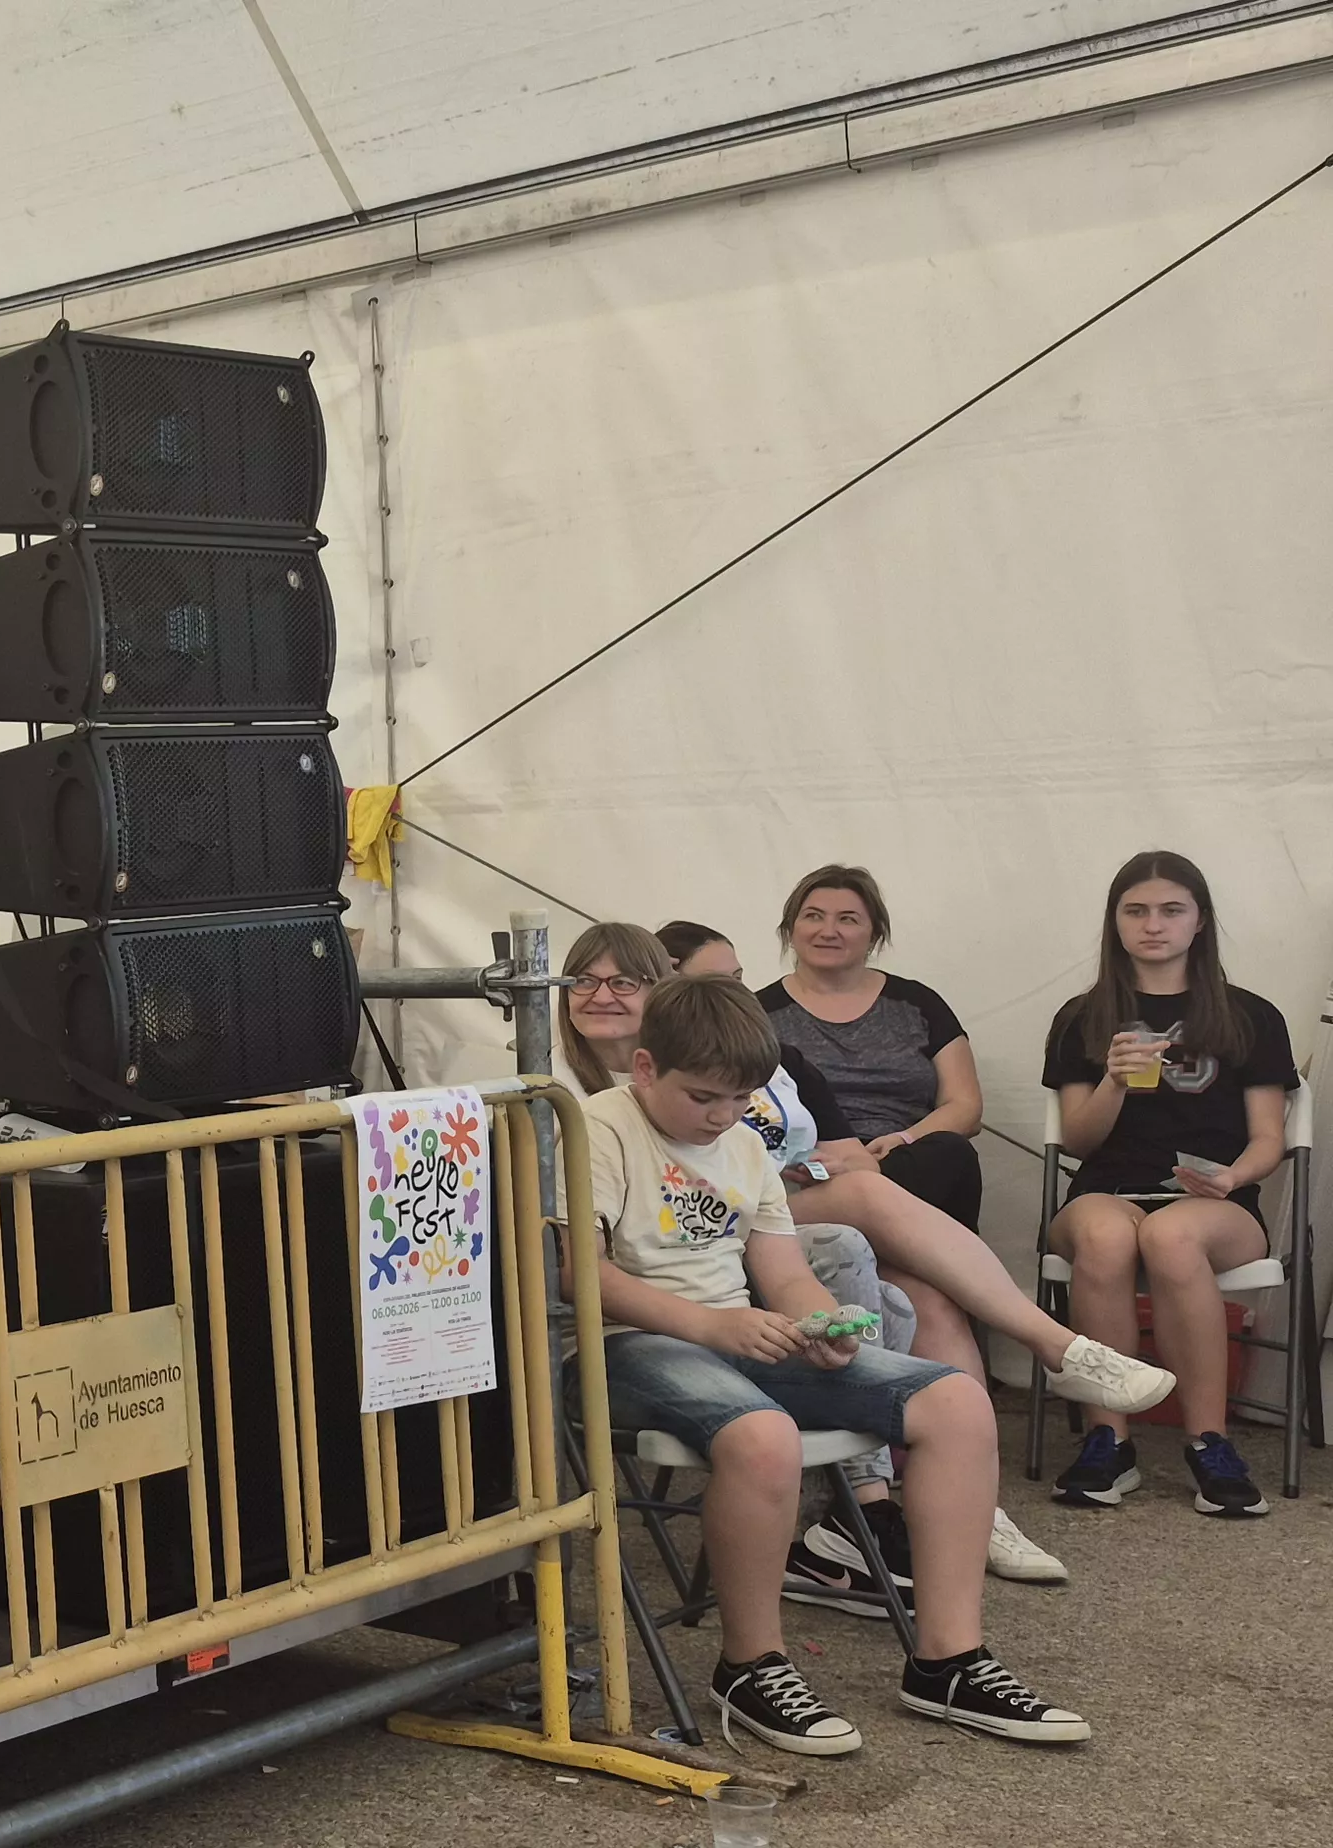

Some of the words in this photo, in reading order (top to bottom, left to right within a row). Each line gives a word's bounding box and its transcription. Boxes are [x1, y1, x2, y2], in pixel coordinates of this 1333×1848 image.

[395, 1195, 455, 1244] FEST
[371, 1302, 420, 1320] 06.06.2026
[431, 1296, 452, 1309] 12.00
[453, 1297, 459, 1305] a
[461, 1291, 482, 1304] 21.00
[78, 1364, 181, 1405] Ayuntamiento
[79, 1411, 99, 1430] de
[107, 1396, 164, 1424] Huesca
